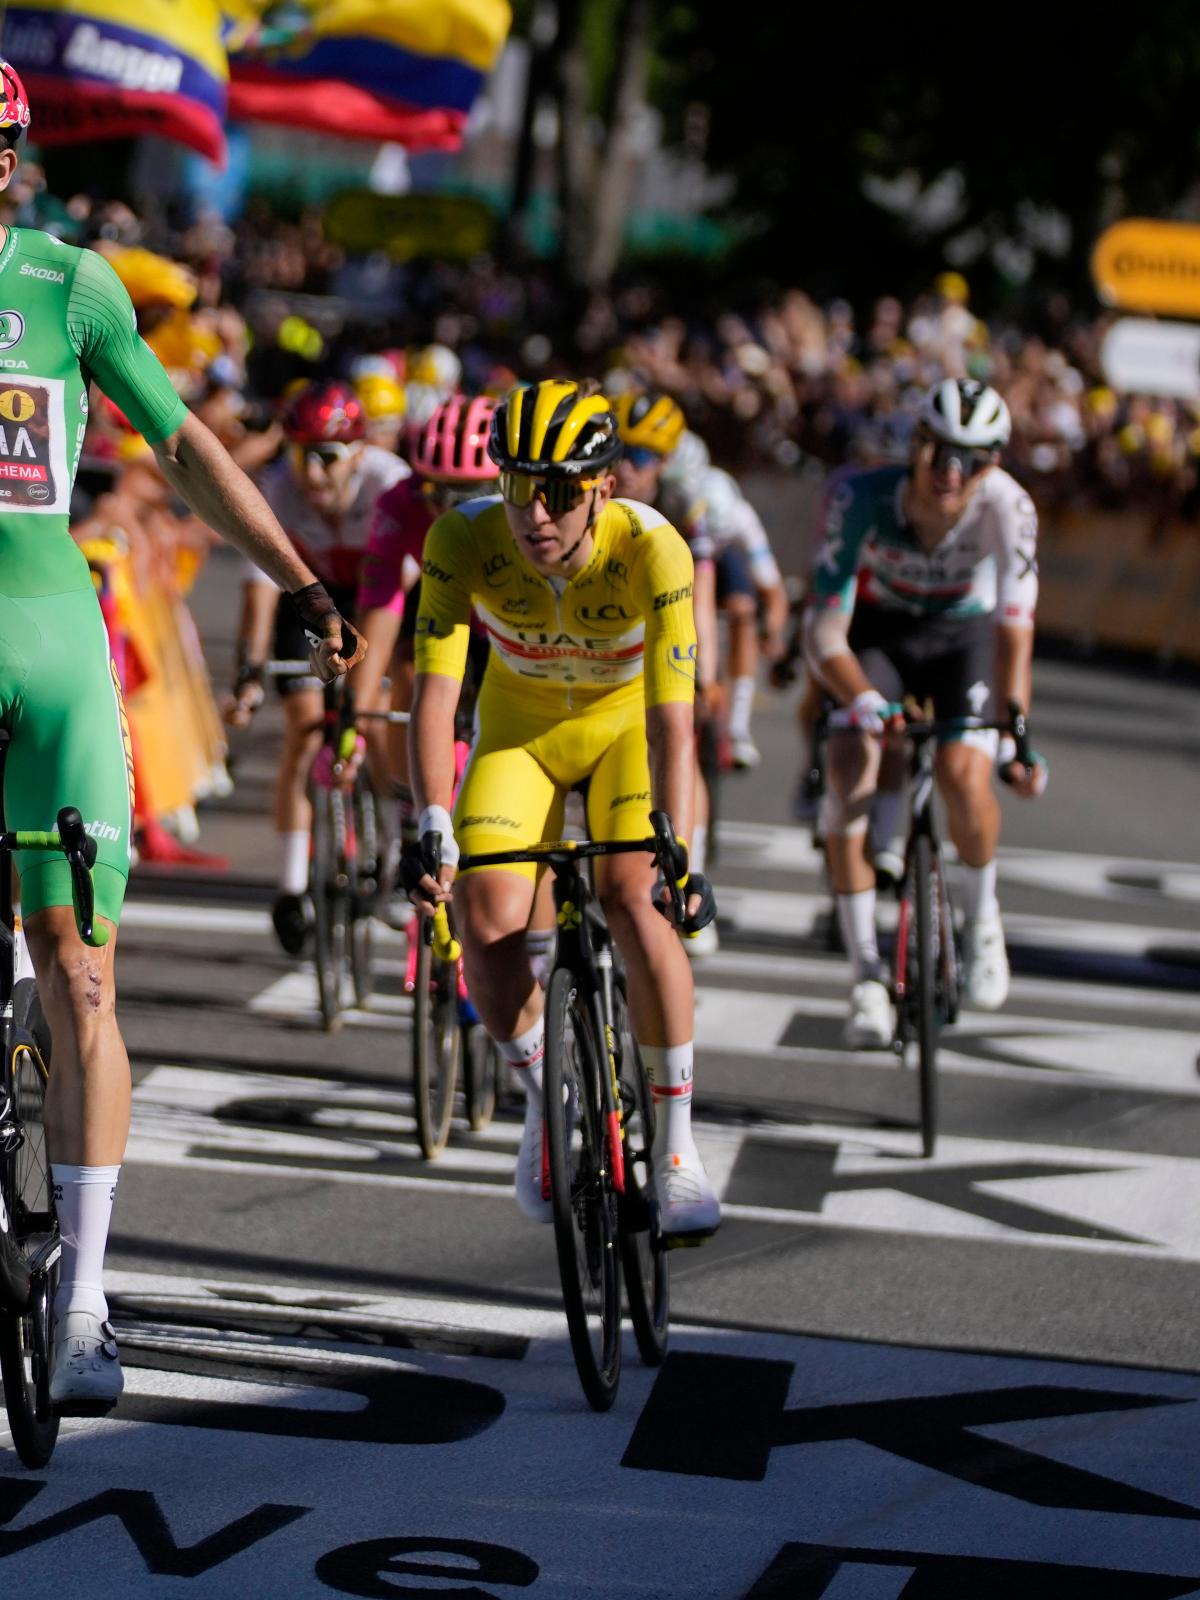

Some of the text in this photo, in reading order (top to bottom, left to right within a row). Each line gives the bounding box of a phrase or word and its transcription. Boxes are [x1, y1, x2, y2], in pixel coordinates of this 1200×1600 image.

[19, 263, 65, 285] ŠKODA
[485, 553, 511, 576] LCL
[581, 604, 633, 622] LCL
[414, 617, 446, 636] CL
[518, 631, 612, 650] UAE
